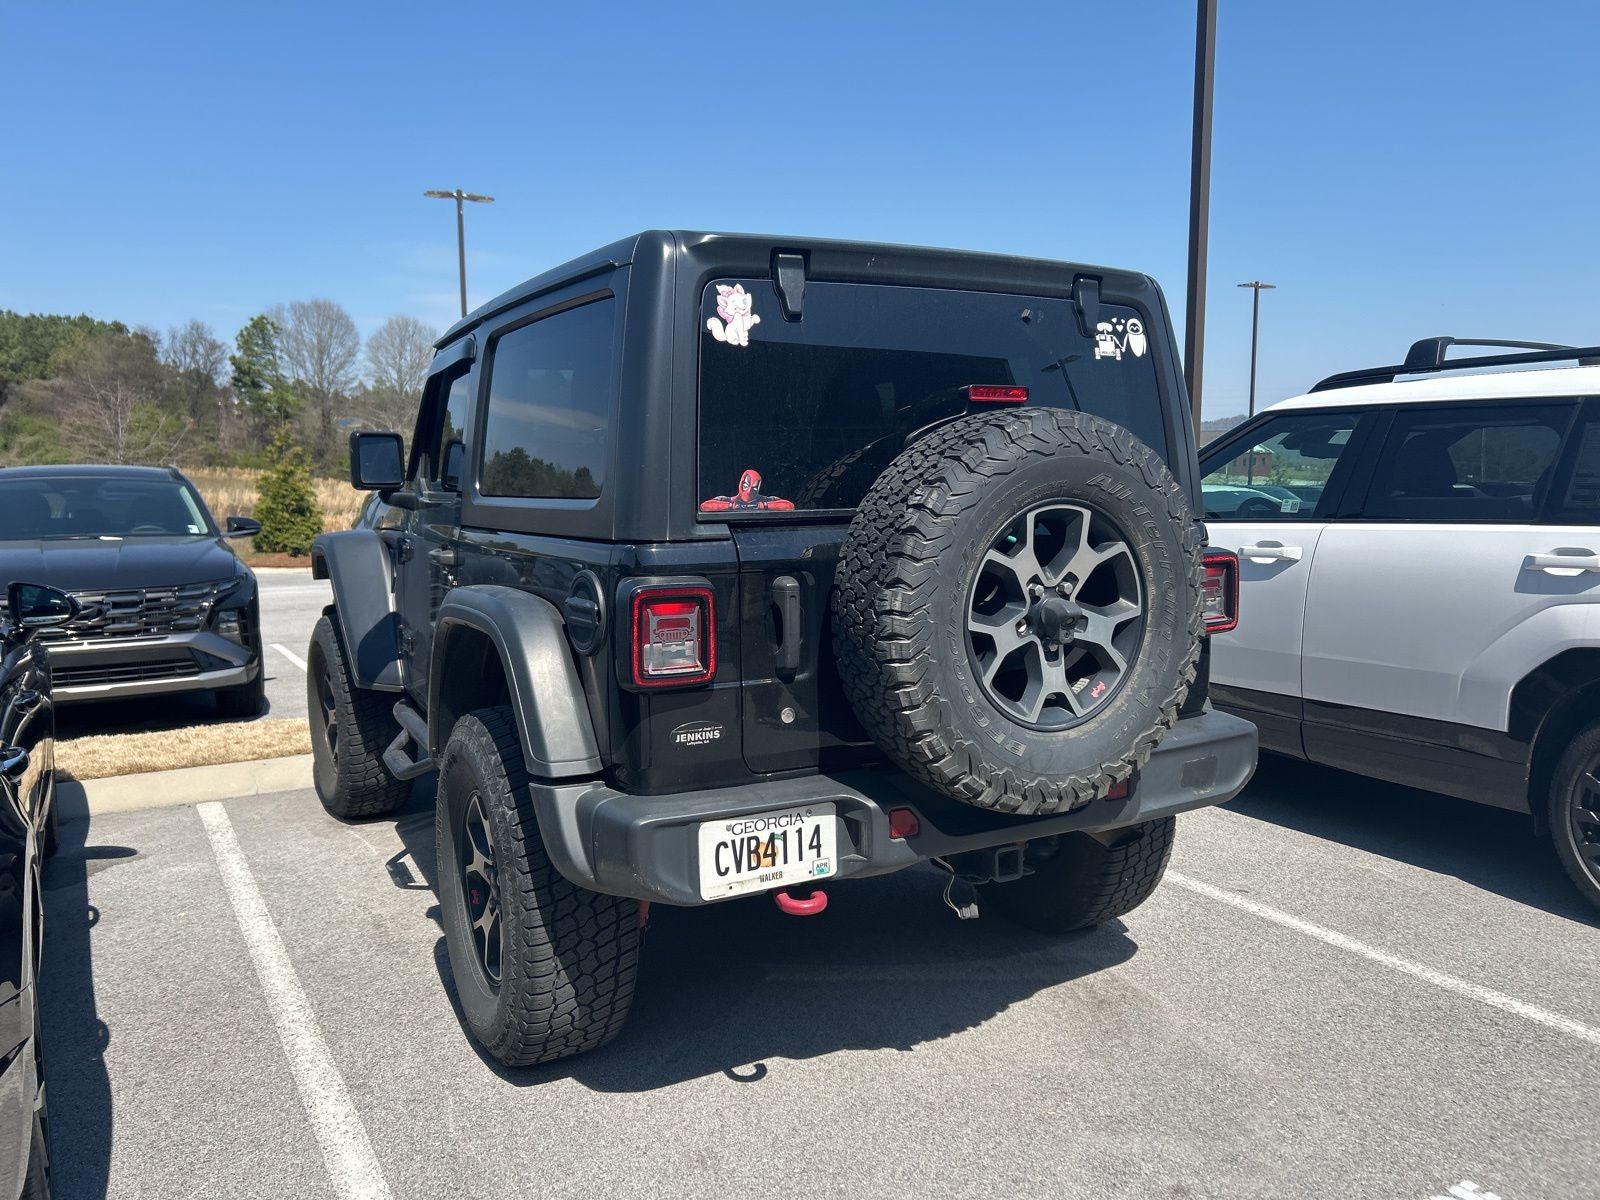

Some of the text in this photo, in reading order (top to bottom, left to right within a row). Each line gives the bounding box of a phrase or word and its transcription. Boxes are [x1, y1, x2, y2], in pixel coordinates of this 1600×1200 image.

[675, 730, 720, 743] JENKINS
[731, 812, 805, 836] GEORGIA
[714, 824, 823, 877] CVB4114
[759, 870, 783, 883] WALKER
